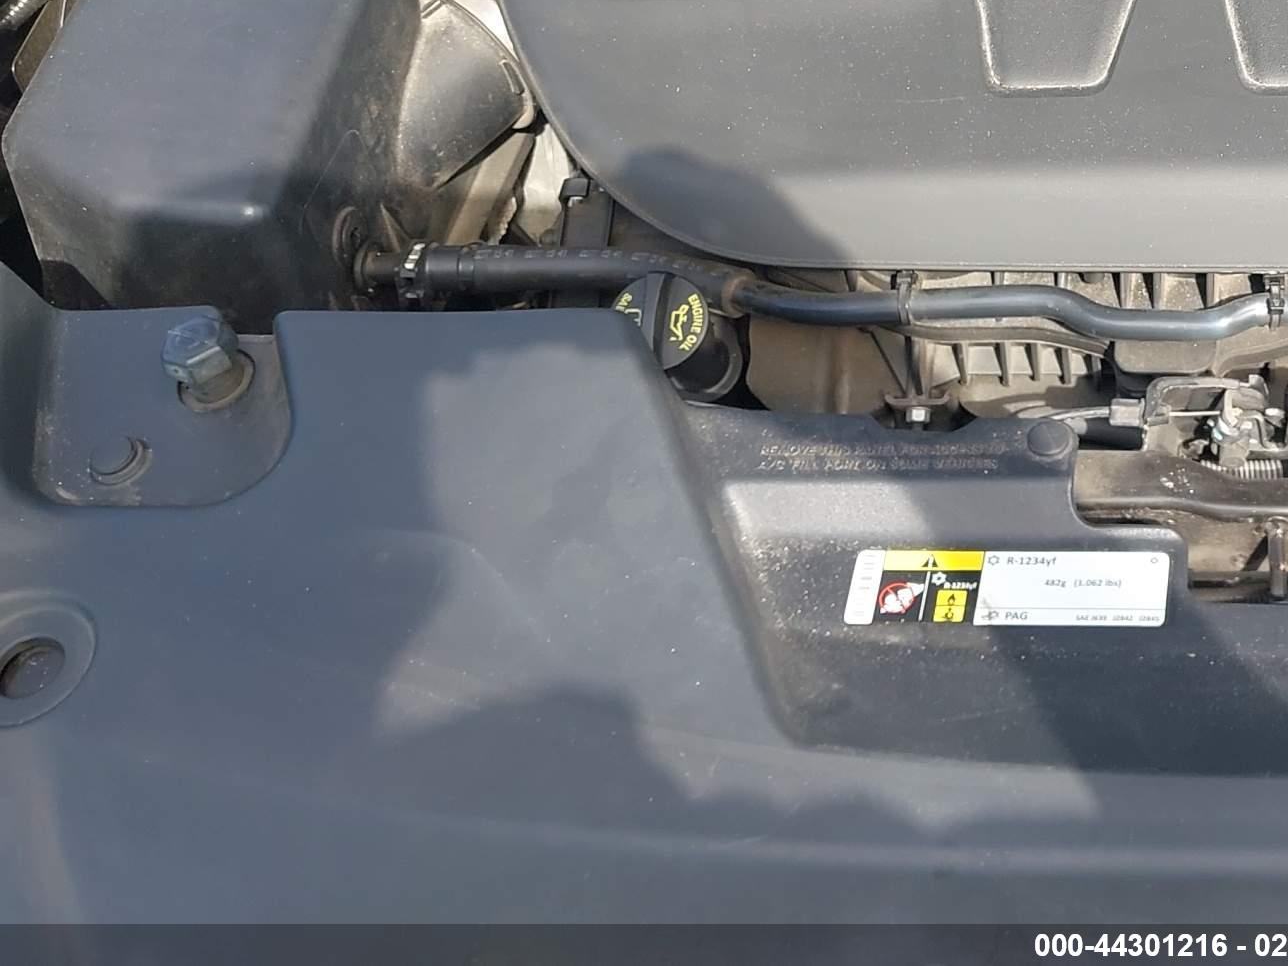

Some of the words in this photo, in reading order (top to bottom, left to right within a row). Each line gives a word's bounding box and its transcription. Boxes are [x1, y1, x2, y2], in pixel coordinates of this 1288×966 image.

[687, 293, 703, 333] ENGINE
[679, 334, 697, 351] OIL
[1006, 556, 1057, 567] R-1234yf
[1005, 611, 1029, 621] PAG
